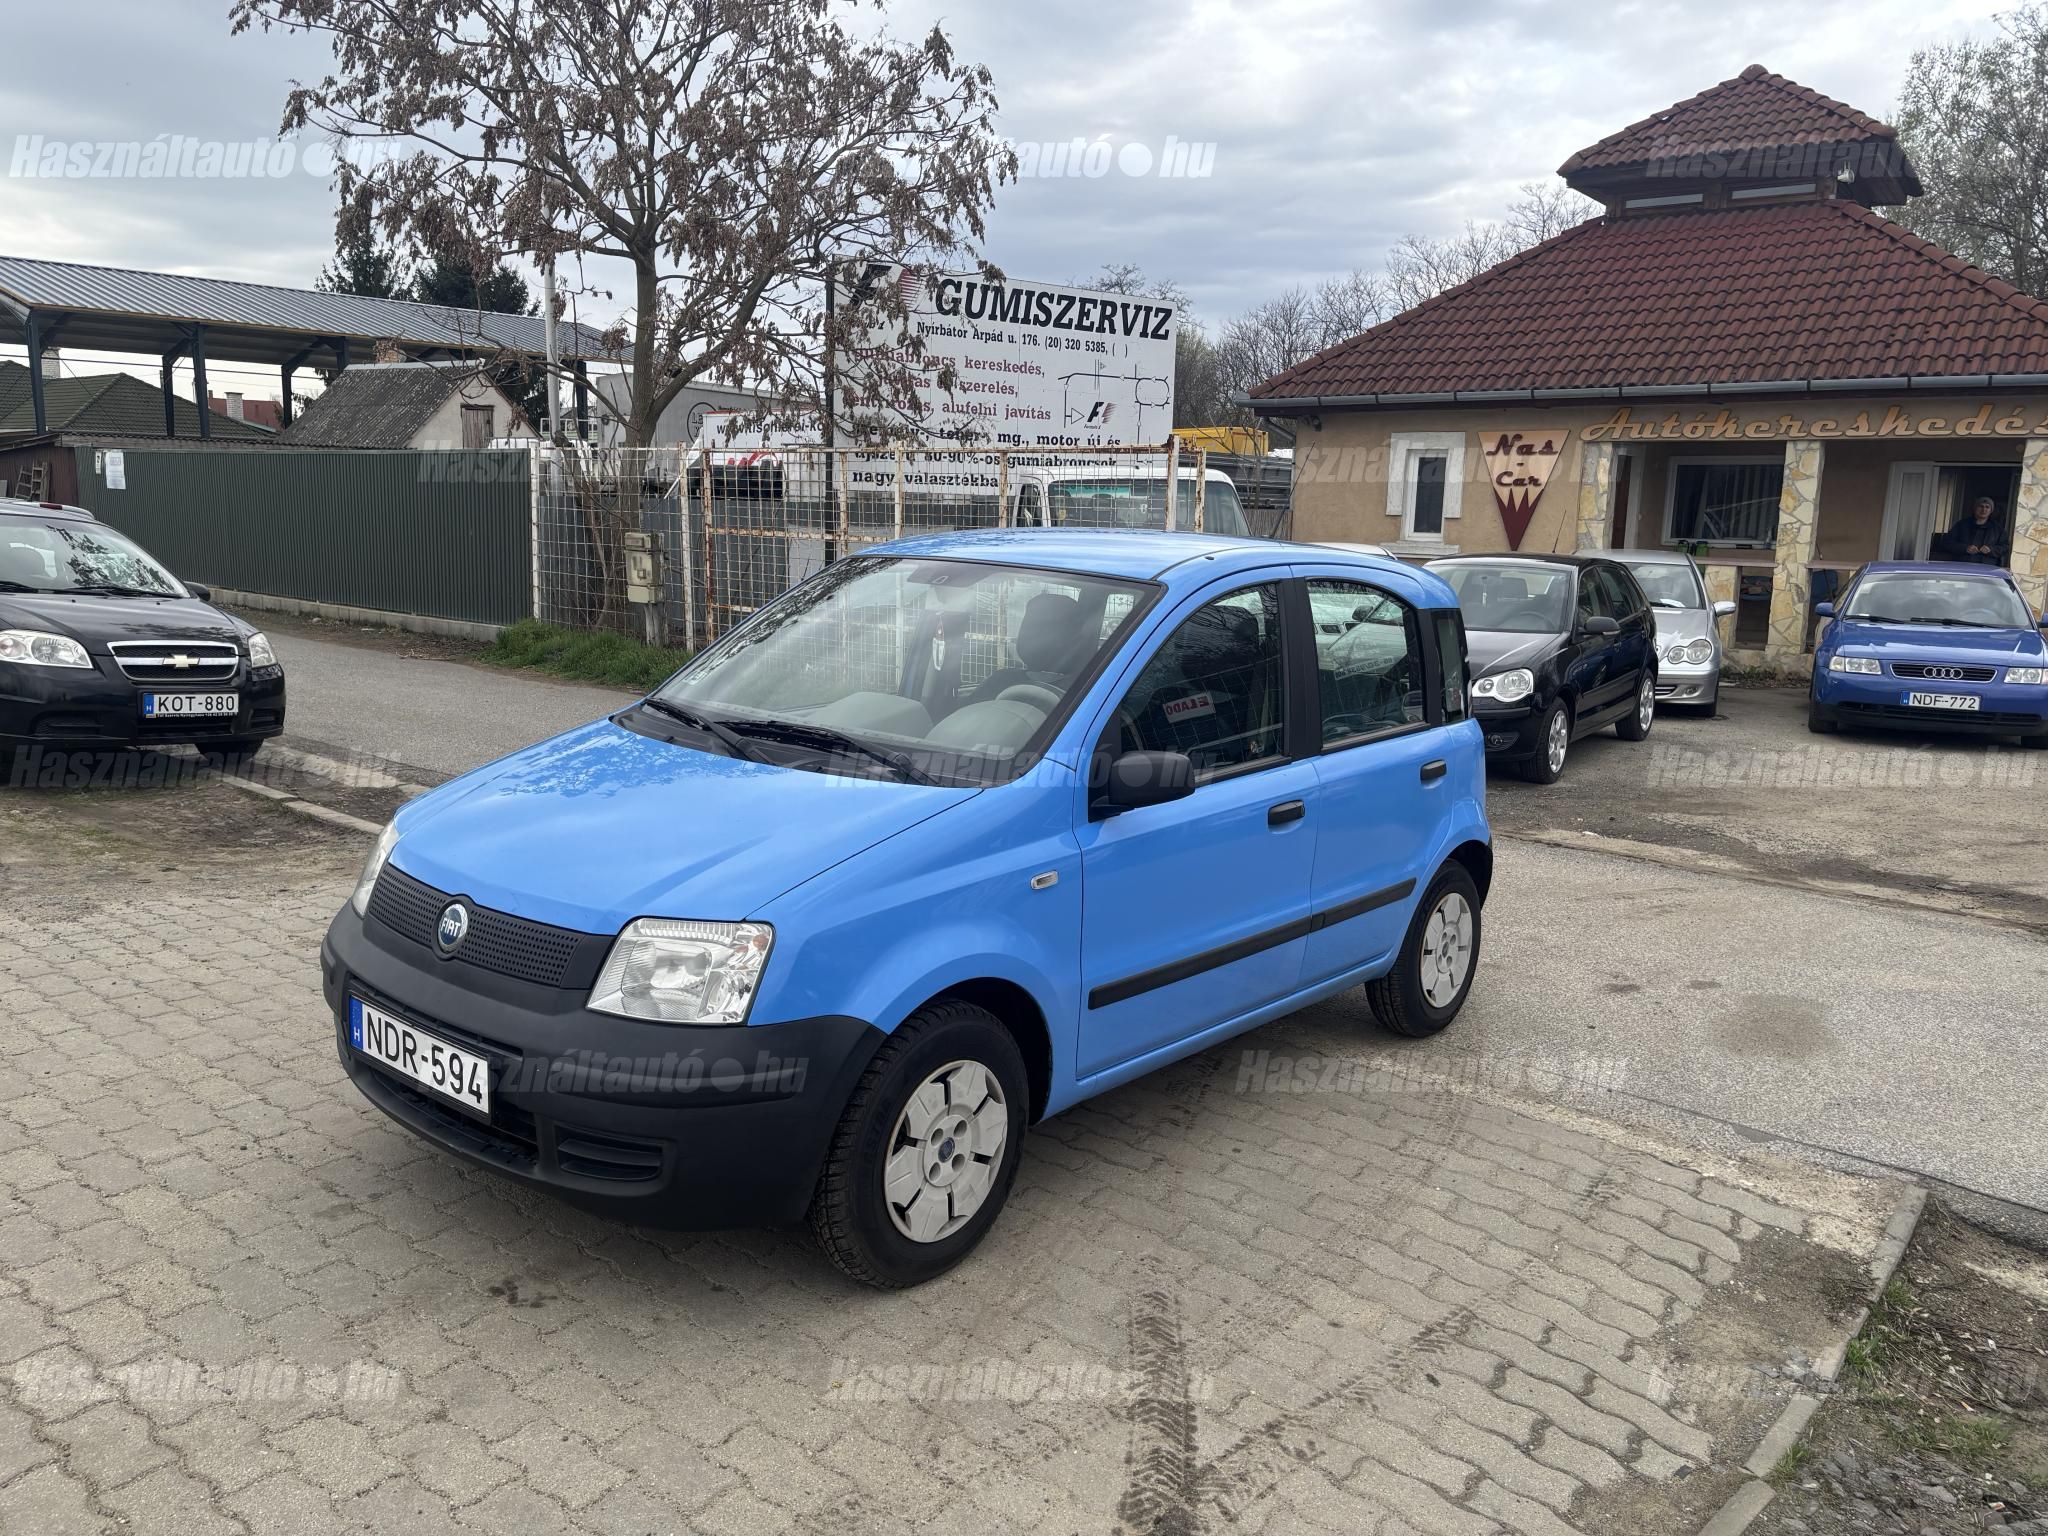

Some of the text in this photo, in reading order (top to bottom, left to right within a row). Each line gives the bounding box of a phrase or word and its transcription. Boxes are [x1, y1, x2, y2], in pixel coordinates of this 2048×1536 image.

[935, 279, 1173, 341] GUMISZERVIZ
[917, 321, 968, 338] Nyírbátor
[1008, 335, 1017, 344] u.
[1022, 333, 1041, 347] 176.
[1044, 335, 1062, 351] (20)
[1064, 338, 1081, 351] 320
[1085, 341, 1108, 356] 5385,
[964, 355, 1045, 378] kereskedés,
[959, 378, 1018, 398] szerelés,
[942, 401, 998, 417] alufelni
[1004, 404, 1052, 420] javítás
[997, 432, 1030, 447] mg.,
[1036, 434, 1081, 447] motor
[1485, 433, 1559, 456] Nas
[852, 471, 1013, 491] nagy választékba,
[1494, 470, 1542, 487] Car
[157, 696, 235, 712] KOT-880
[1912, 693, 1976, 709] NDF-772
[440, 919, 461, 935] FIAT
[353, 1011, 483, 1104] H NDR-594
